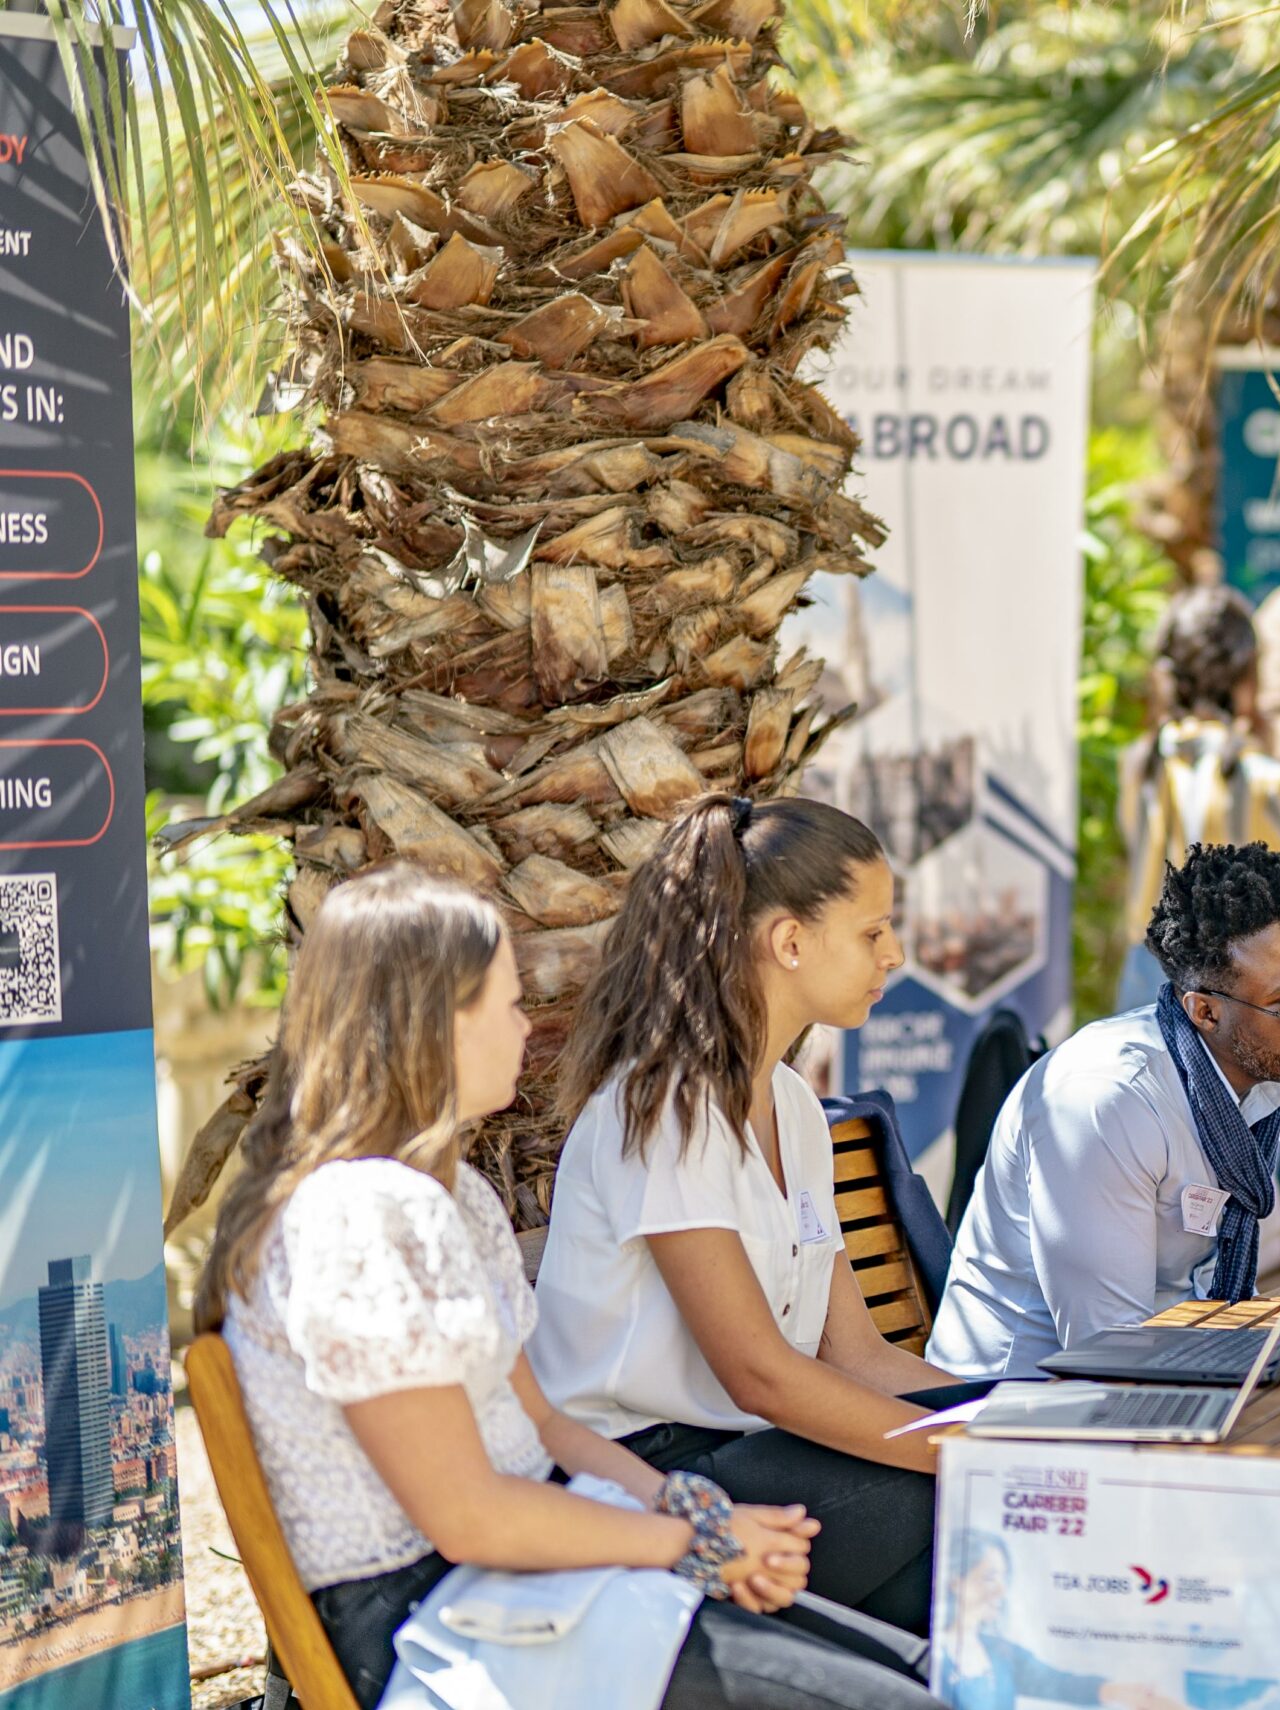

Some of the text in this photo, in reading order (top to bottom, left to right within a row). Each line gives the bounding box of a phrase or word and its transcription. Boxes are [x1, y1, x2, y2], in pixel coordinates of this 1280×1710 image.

[27, 385, 64, 423] IN:
[1003, 1490, 1087, 1514] CAREER
[1002, 1512, 1048, 1534] FAIR
